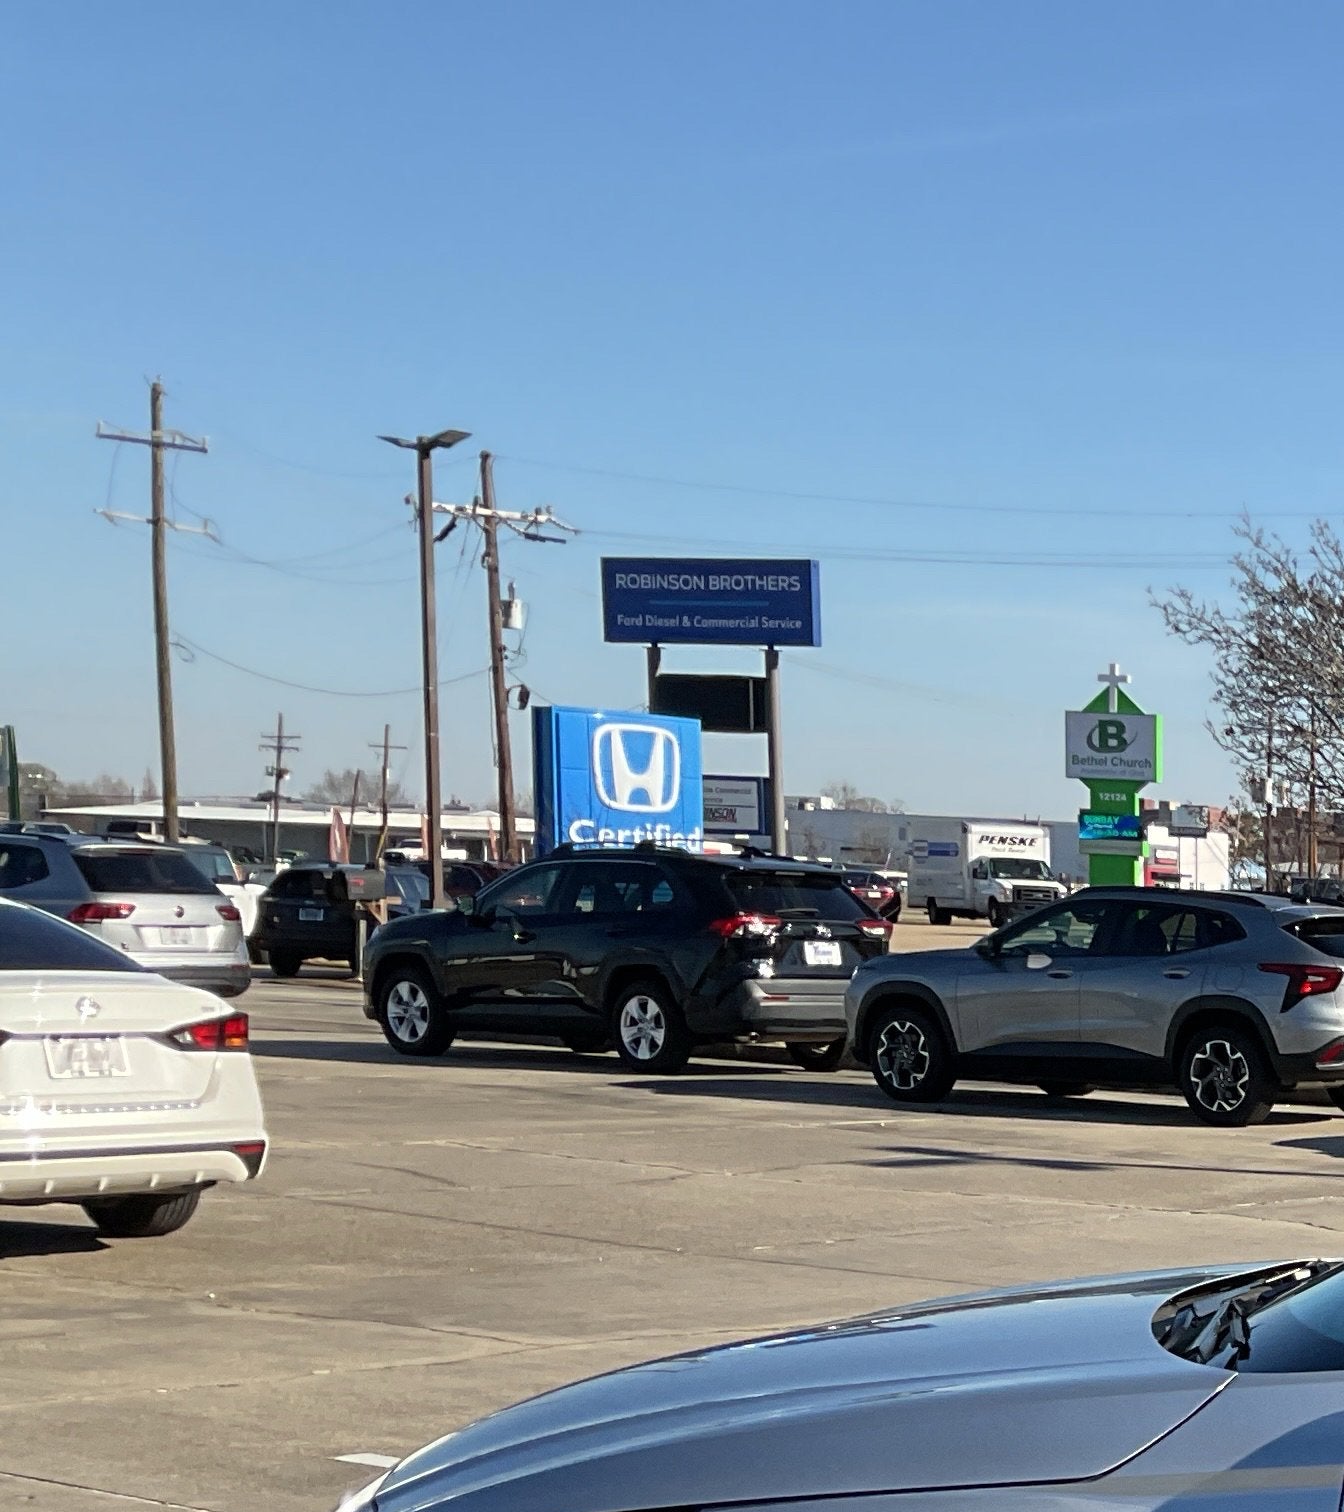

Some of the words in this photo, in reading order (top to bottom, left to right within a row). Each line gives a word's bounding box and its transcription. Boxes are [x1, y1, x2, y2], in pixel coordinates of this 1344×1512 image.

[615, 573, 705, 590] ROBINSON
[708, 575, 801, 591] BROTHERS
[617, 614, 643, 627] Ford
[645, 614, 680, 627] Diesel
[682, 616, 691, 627] &
[693, 615, 759, 628] Commercial
[761, 617, 802, 629] Service
[1071, 754, 1108, 767] Bethel
[1110, 756, 1152, 769] Church
[1099, 792, 1128, 801] 12124
[569, 818, 702, 854] Certified
[978, 834, 1038, 848] PENSKE
